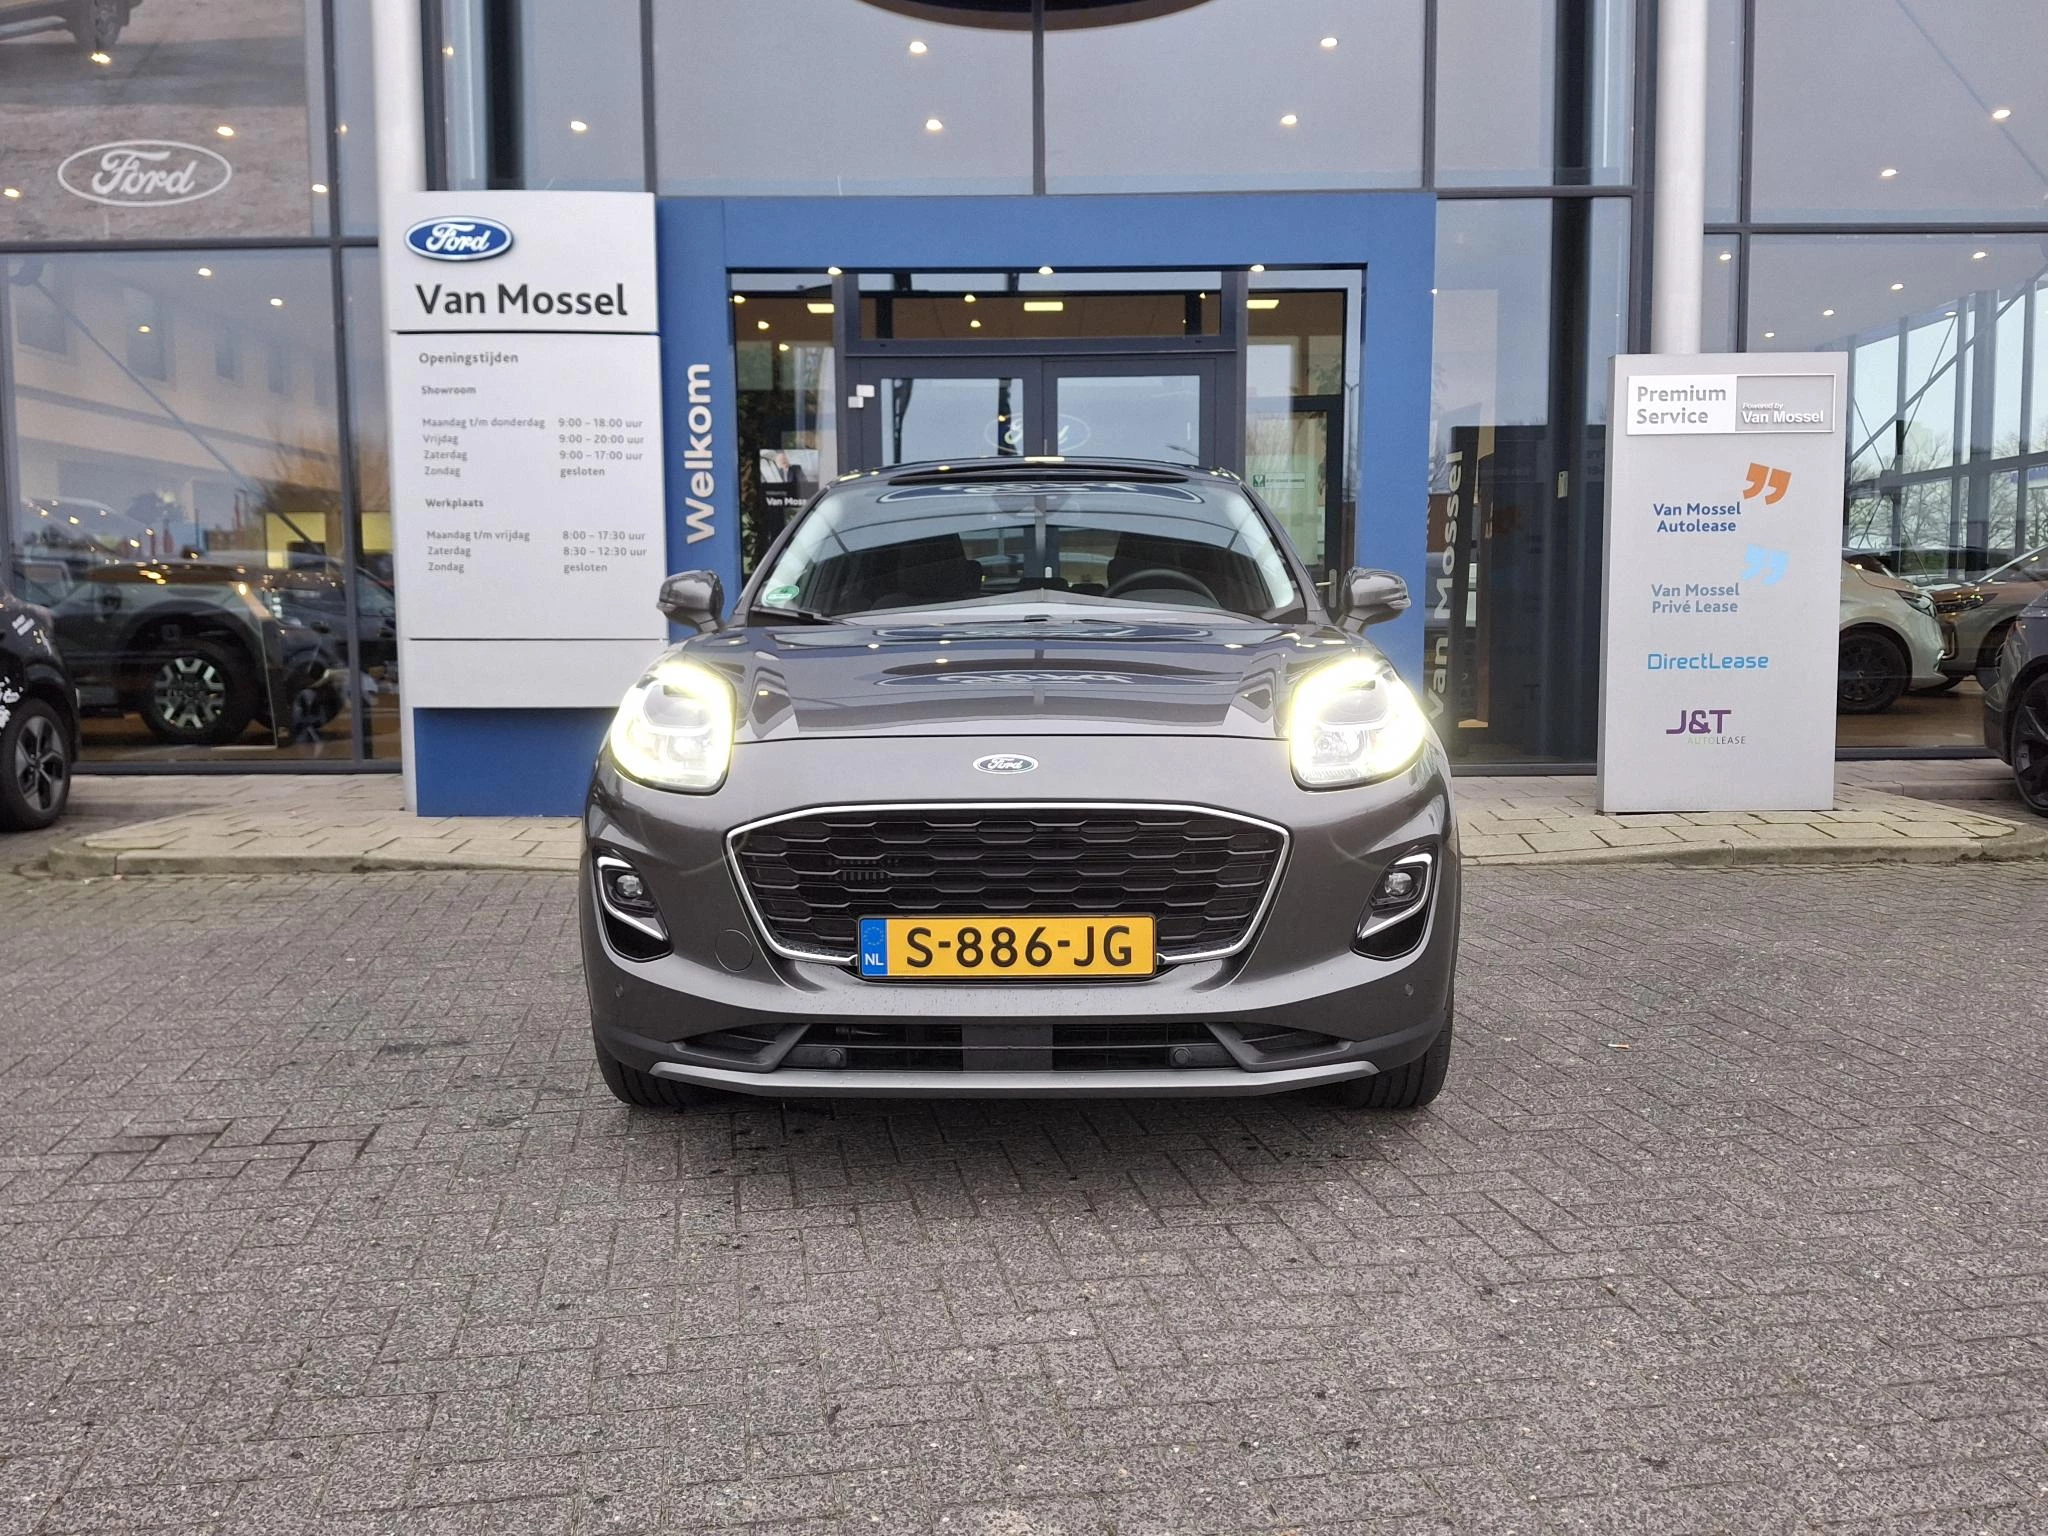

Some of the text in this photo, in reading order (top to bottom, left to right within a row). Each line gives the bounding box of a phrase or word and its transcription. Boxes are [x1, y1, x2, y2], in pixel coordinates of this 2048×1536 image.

[91, 149, 198, 194] Ford
[425, 223, 491, 252] Ford
[415, 283, 628, 316] Van Mossel
[419, 352, 518, 366] Openingstijden
[421, 386, 476, 395] Showroom
[1637, 385, 1726, 402] Premium
[1636, 407, 1709, 424] Service
[1742, 409, 1824, 423] Van Mossel
[422, 418, 467, 428] Maandag
[469, 418, 489, 427] t/m
[491, 418, 546, 429] donderdag
[558, 418, 582, 428] 9:00
[594, 418, 622, 428] 18:00
[625, 420, 643, 428] uur
[423, 434, 459, 446] Vrijdag
[559, 434, 583, 443] 9:00
[594, 434, 625, 444] 20:00
[627, 436, 644, 444] uur
[424, 450, 468, 461] Zaterdag
[560, 450, 583, 460] 9:00
[595, 451, 623, 460] 17:00
[625, 452, 643, 460] uur
[684, 364, 715, 544] Welkom
[424, 466, 605, 477] Zondag gesloten
[425, 498, 484, 509] Werkplaats
[766, 497, 782, 506] Van
[1653, 502, 1741, 516] Van Mossel
[1657, 519, 1736, 533] Autolease
[426, 531, 471, 541] Maandag
[474, 531, 492, 540] t/m
[495, 531, 530, 542] vrijdag
[563, 531, 586, 540] 8:00
[598, 531, 625, 540] 17:30
[427, 547, 471, 557] Zaterdag
[563, 547, 587, 556] 8:30
[599, 547, 627, 556] 12:30
[428, 562, 607, 573] Zondag gesloten
[1426, 451, 1463, 720] Van Mossel
[1651, 583, 1740, 597] Van Mossel
[1652, 600, 1738, 613] Privé Lease
[1648, 653, 1768, 669] DirectLease
[1666, 710, 1732, 734] J&T
[1687, 736, 1746, 744] AUTOLEASE
[988, 758, 1024, 769] Ford
[906, 926, 1132, 968] S-886-JG
[864, 954, 884, 966] NL
